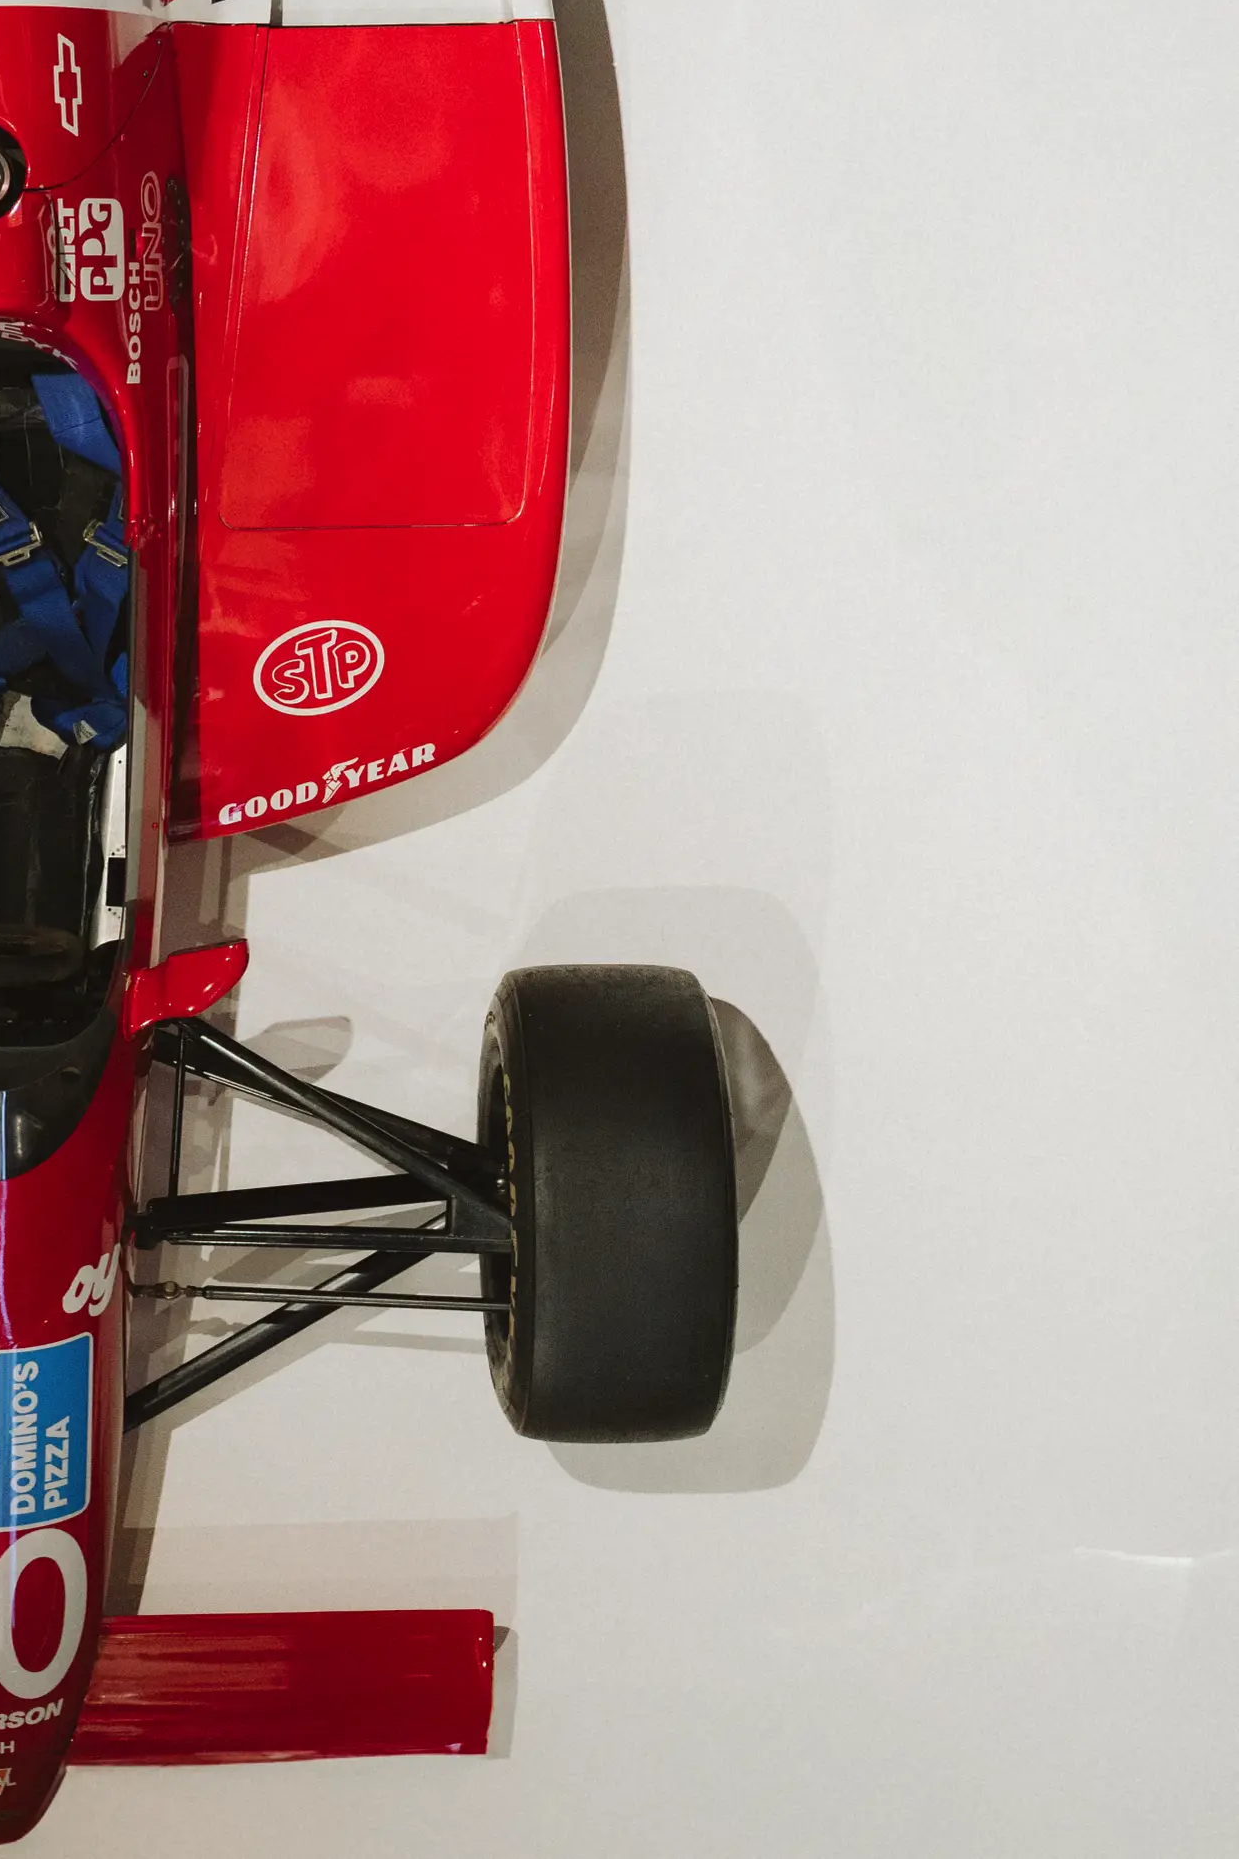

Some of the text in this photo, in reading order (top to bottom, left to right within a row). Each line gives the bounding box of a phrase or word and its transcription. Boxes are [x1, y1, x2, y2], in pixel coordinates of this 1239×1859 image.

[57, 198, 76, 303] CART
[141, 171, 164, 311] UNO
[126, 262, 141, 385] BOSCH
[271, 629, 370, 705] STP
[10, 1360, 39, 1516] DOMINO'S
[44, 1415, 70, 1511] PIZZA
